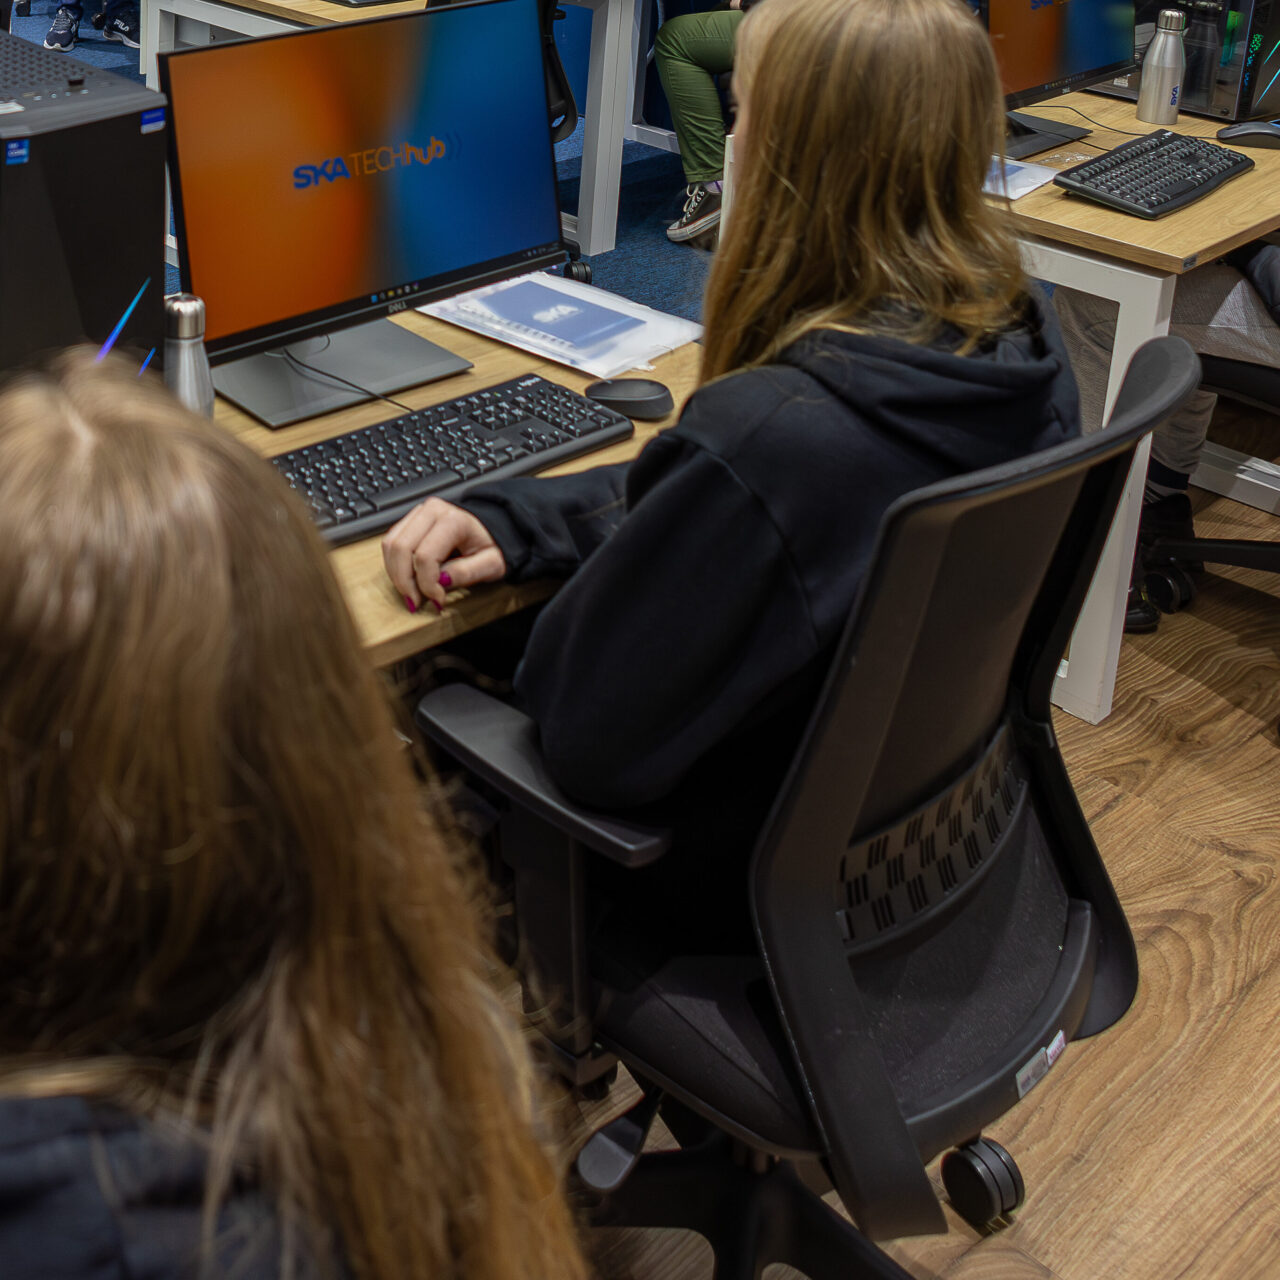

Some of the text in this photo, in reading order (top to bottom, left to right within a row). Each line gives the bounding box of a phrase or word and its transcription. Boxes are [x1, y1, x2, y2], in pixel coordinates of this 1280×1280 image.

[114, 18, 130, 32] FILA
[1170, 86, 1179, 106] SKA
[293, 156, 351, 189] SKA
